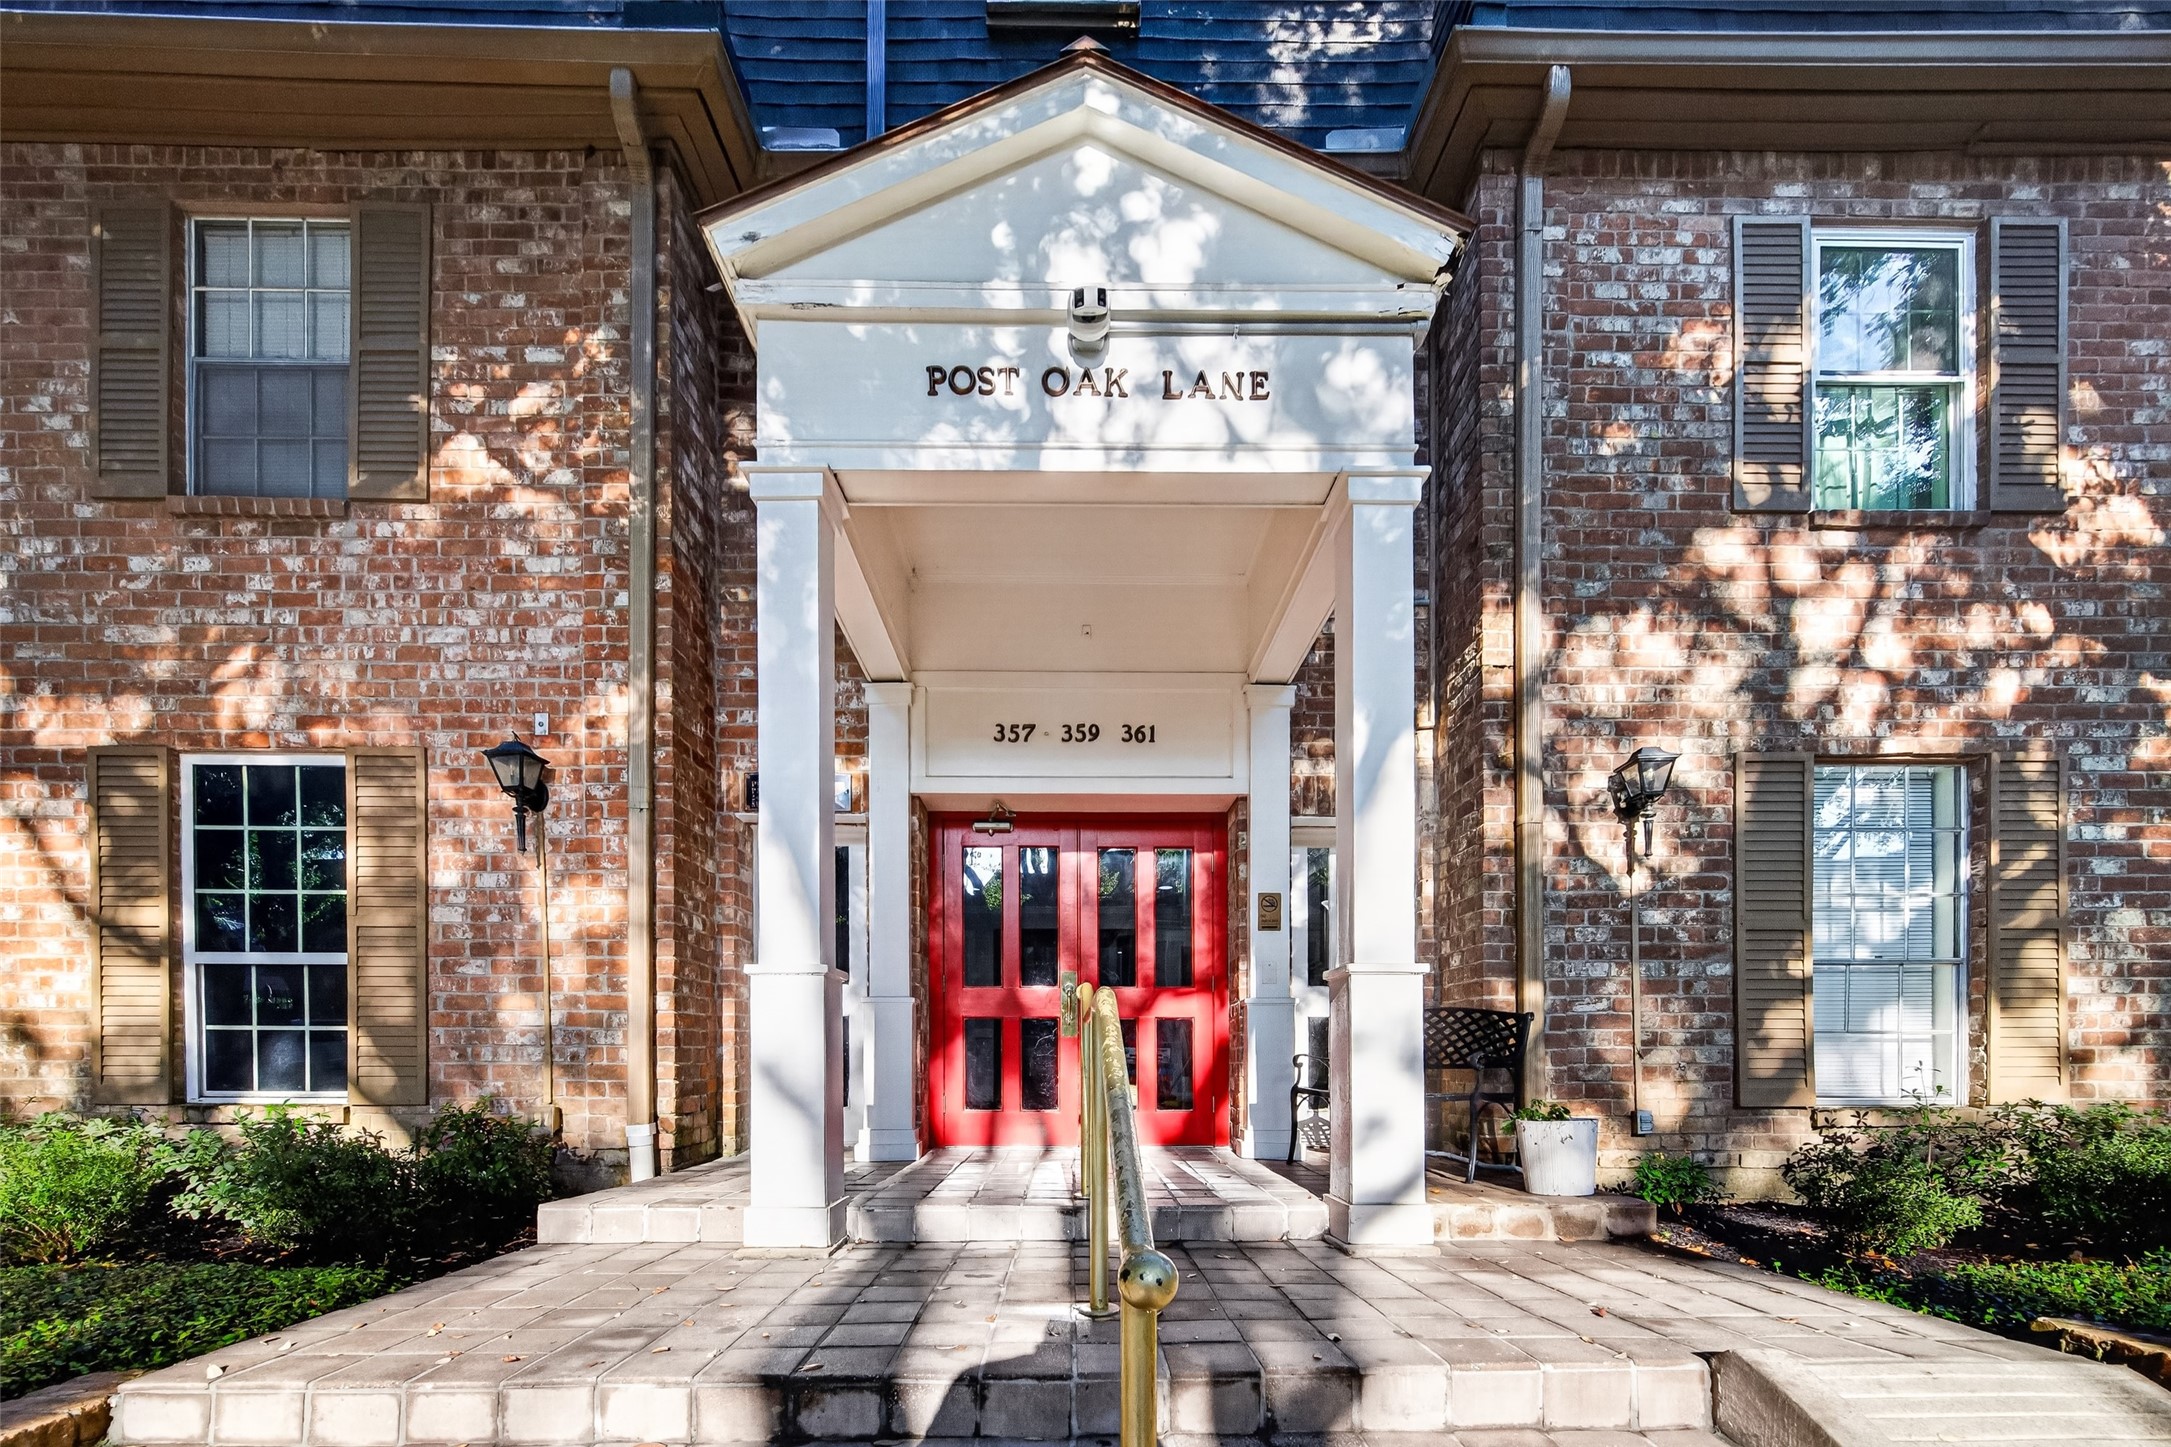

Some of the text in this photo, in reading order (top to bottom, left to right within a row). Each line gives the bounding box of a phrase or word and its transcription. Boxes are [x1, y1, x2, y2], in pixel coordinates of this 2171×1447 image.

[926, 365, 1271, 400] POST OAK LANE
[993, 723, 1156, 743] 357 359 361
